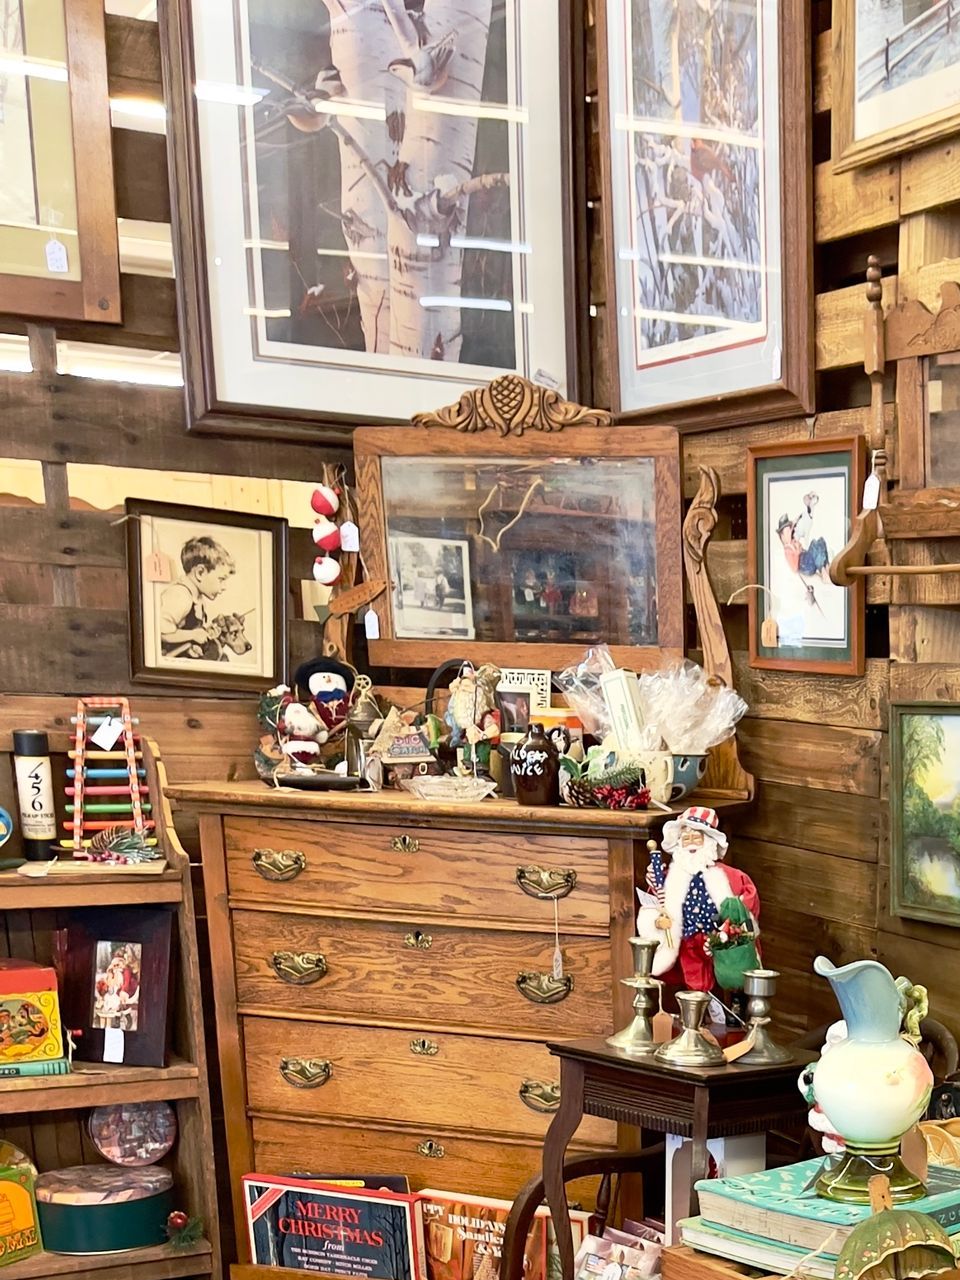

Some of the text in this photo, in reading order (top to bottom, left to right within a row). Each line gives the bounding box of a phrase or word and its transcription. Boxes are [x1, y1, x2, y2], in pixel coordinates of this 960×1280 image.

[296, 1200, 361, 1225] MERRY
[279, 1217, 383, 1247] CHRISTMAS
[322, 1240, 345, 1252] from
